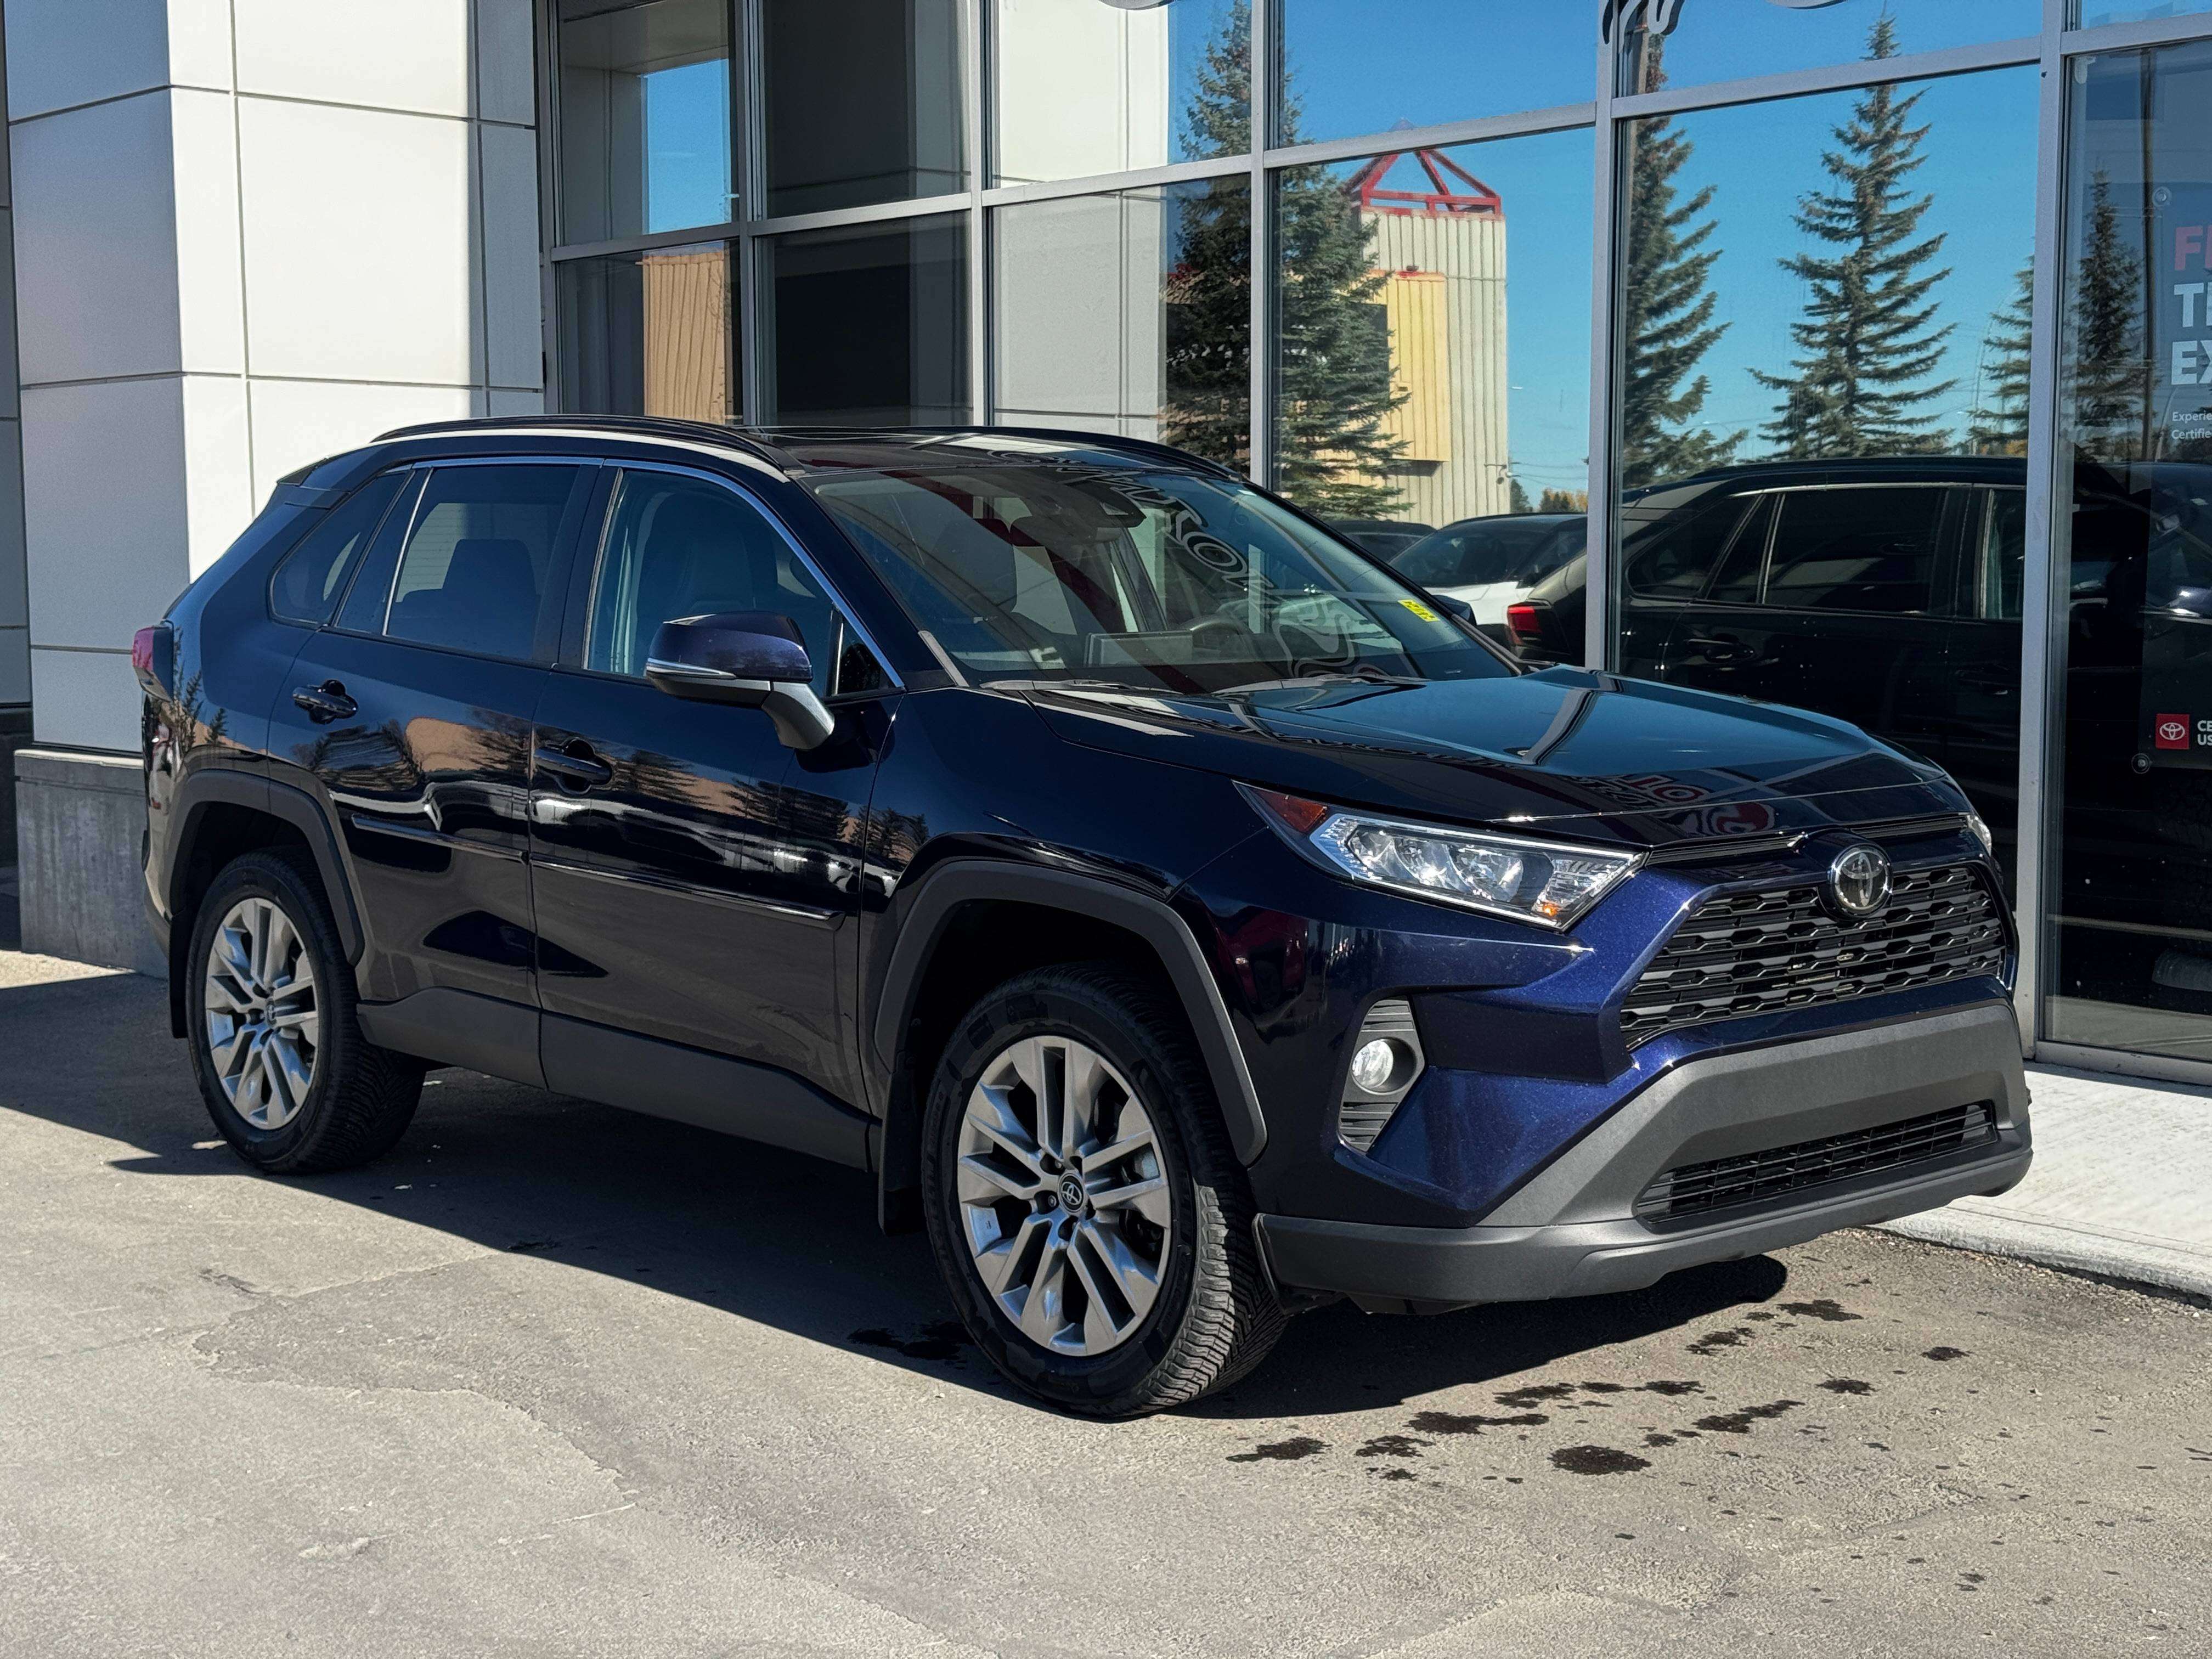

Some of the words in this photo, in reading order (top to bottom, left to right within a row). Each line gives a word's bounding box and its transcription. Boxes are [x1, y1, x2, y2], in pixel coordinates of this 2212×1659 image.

[2175, 224, 2212, 270] F
[2174, 282, 2212, 328] T
[2171, 428, 2212, 439] Certifie
